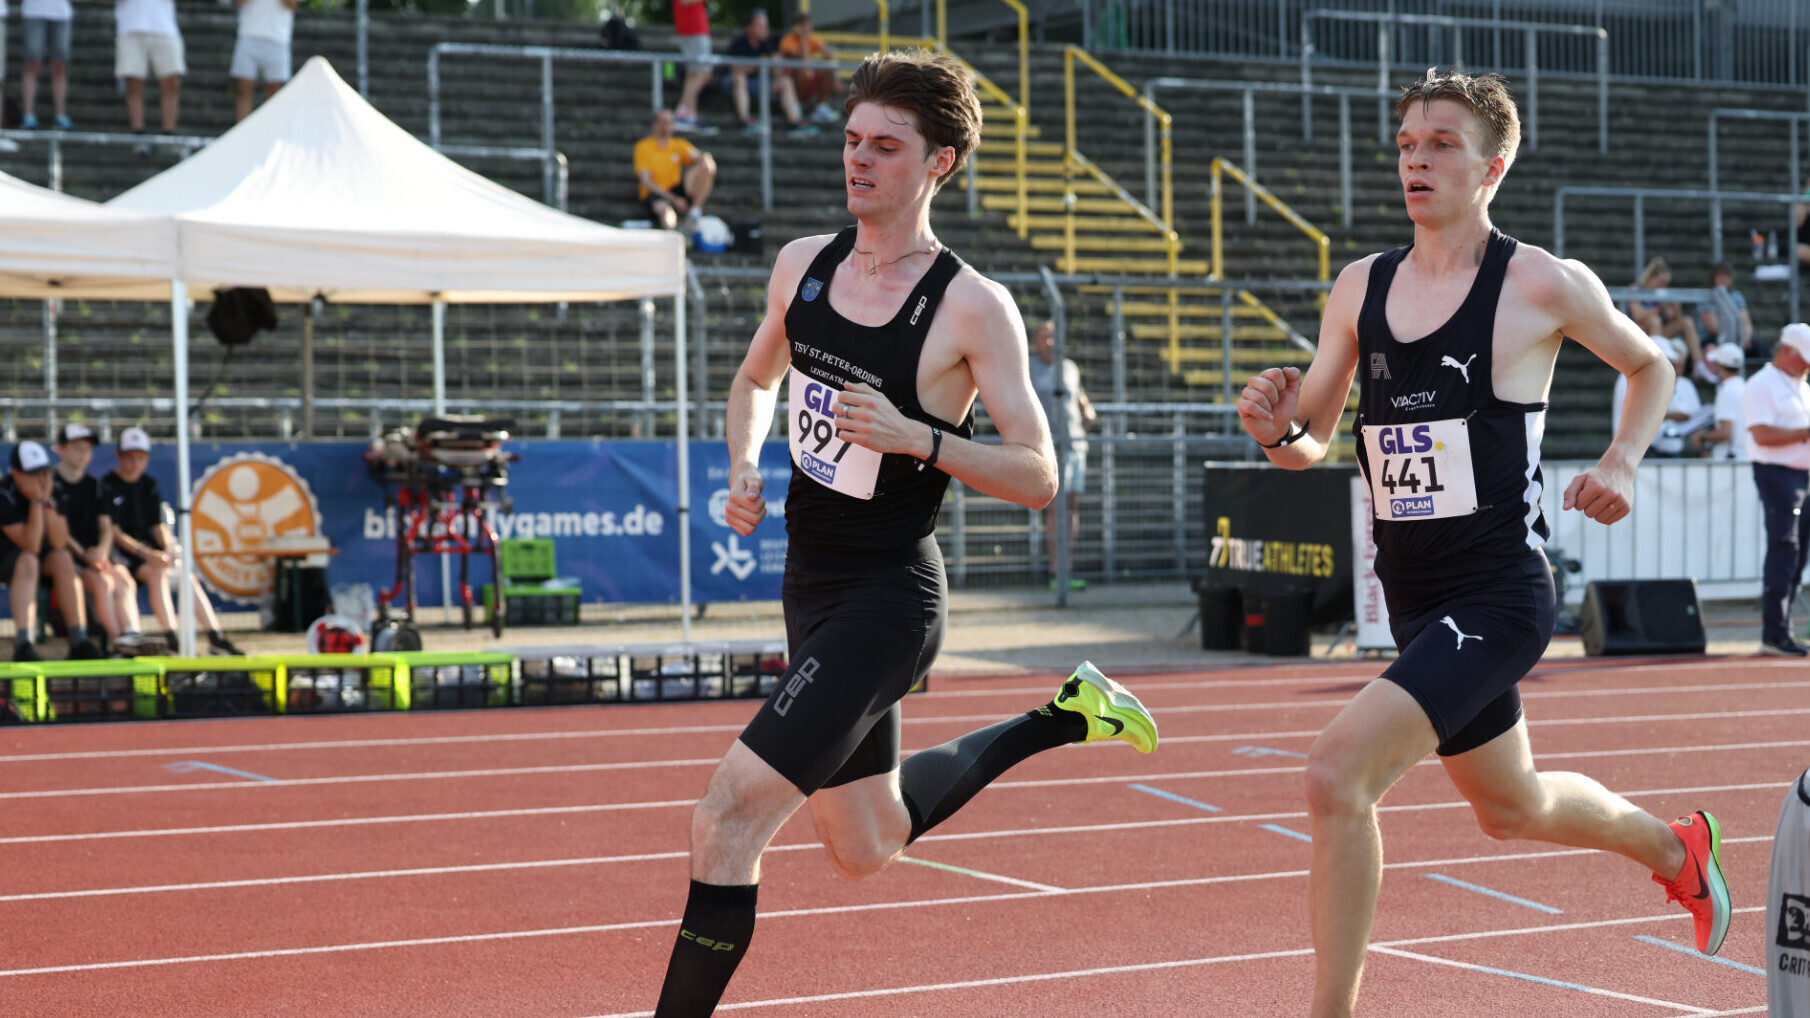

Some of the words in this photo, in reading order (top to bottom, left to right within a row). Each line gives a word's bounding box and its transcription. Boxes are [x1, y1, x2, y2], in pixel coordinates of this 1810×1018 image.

[909, 295, 928, 326] cep
[794, 342, 810, 355] TSV
[804, 382, 837, 420] GL
[811, 460, 834, 477] PLAN
[1381, 456, 1445, 495] 441
[1405, 500, 1432, 510] PLAN
[773, 656, 821, 717] cep
[680, 928, 735, 952] cep
